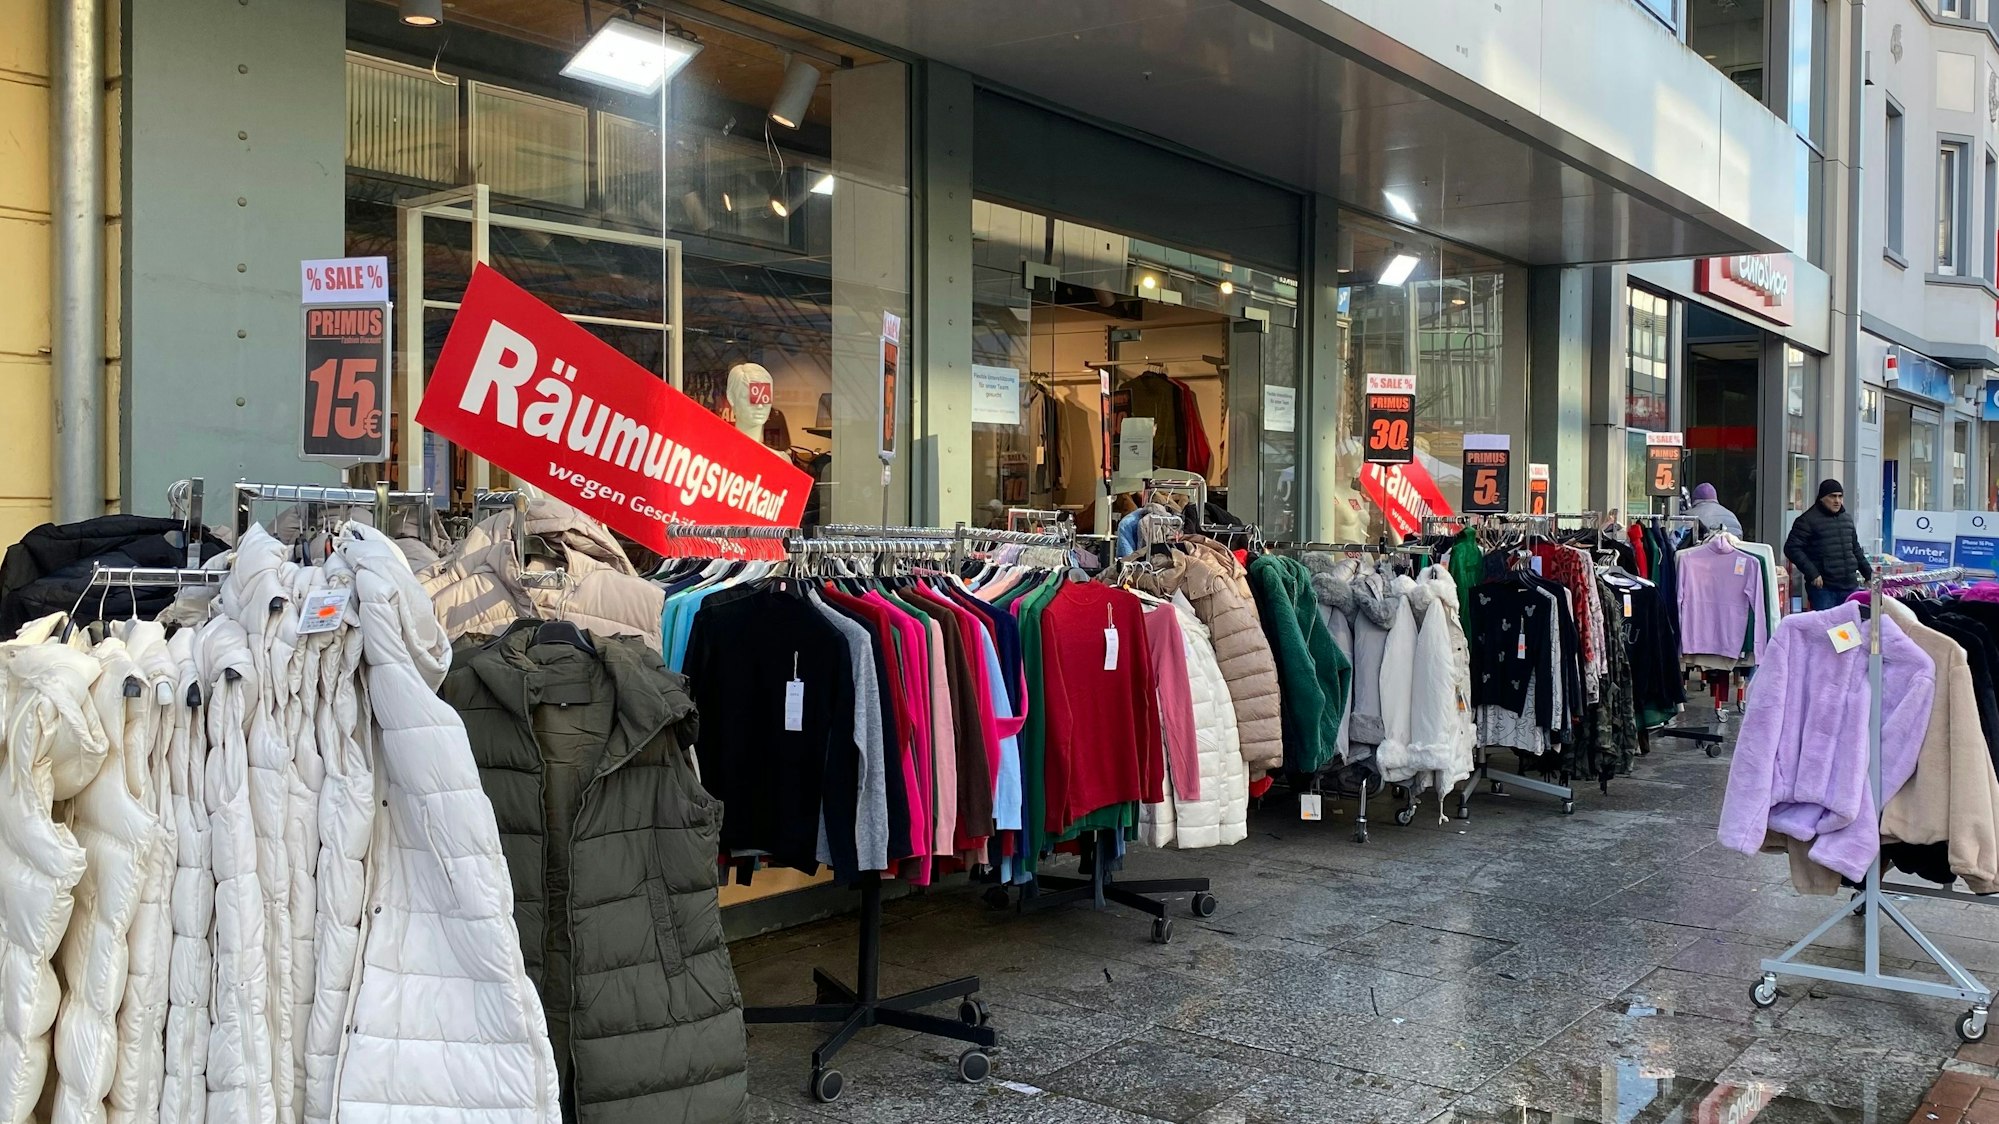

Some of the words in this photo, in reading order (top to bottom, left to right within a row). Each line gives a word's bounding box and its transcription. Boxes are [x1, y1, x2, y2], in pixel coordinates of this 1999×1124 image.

[306, 267, 322, 291] %
[325, 266, 364, 290] SALE
[367, 265, 383, 289] %
[1380, 378, 1402, 389] SALE
[309, 358, 382, 440] 15€
[458, 319, 788, 522] Räumungsverkauf
[1370, 418, 1409, 450] 30€
[1656, 435, 1673, 443] SALE
[549, 461, 626, 505] wegen
[1473, 469, 1500, 505] 5€
[1655, 463, 1676, 490] 5€
[1901, 545, 1945, 558] Winter
[1928, 555, 1949, 564] Deals
